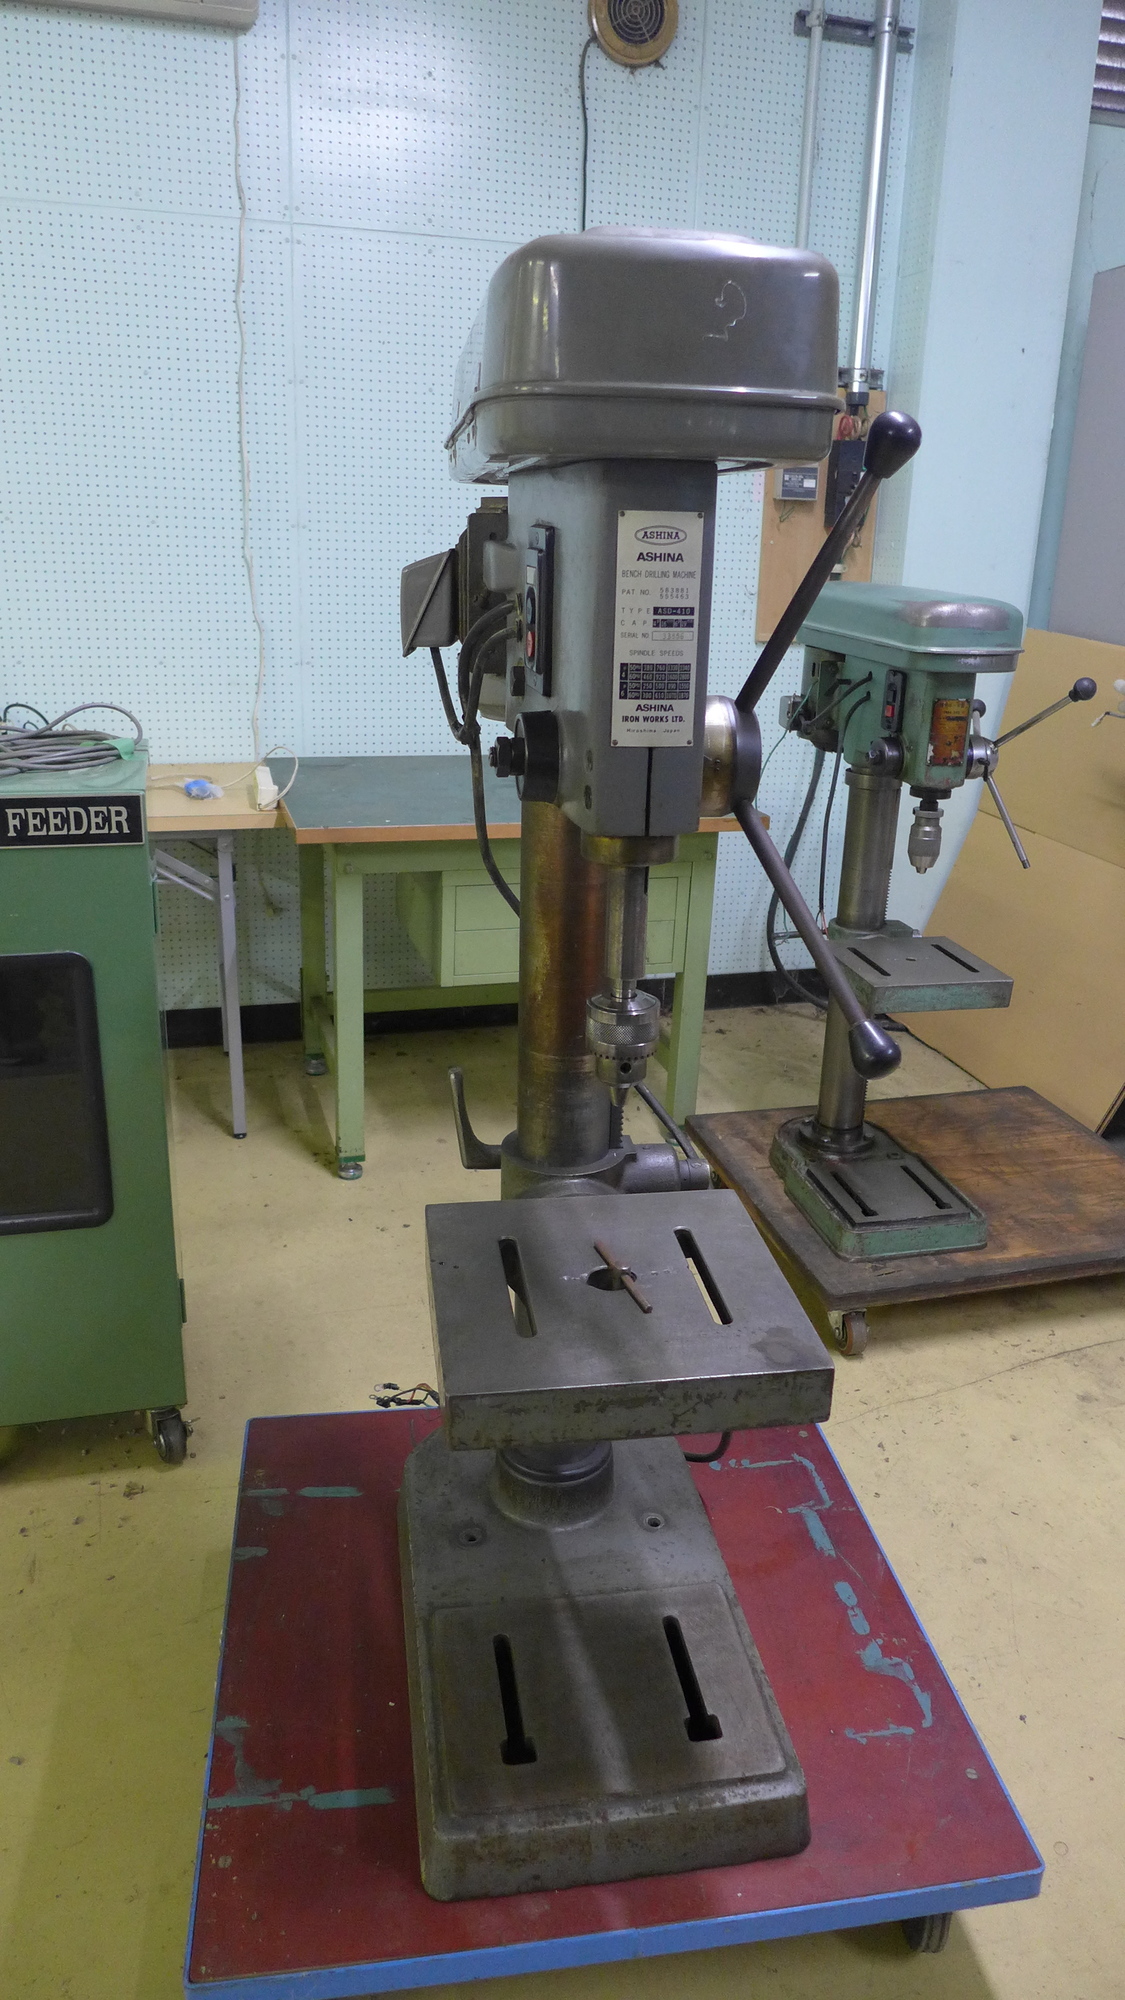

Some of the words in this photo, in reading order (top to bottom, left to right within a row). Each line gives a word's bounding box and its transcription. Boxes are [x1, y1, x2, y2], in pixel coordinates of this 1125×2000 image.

[642, 531, 680, 540] ASHINA
[636, 552, 684, 562] ASHINA
[645, 570, 670, 579] DRILLING
[673, 571, 696, 579] MACHINE
[636, 704, 674, 712] ASHINA
[5, 806, 130, 836] FEEDER
